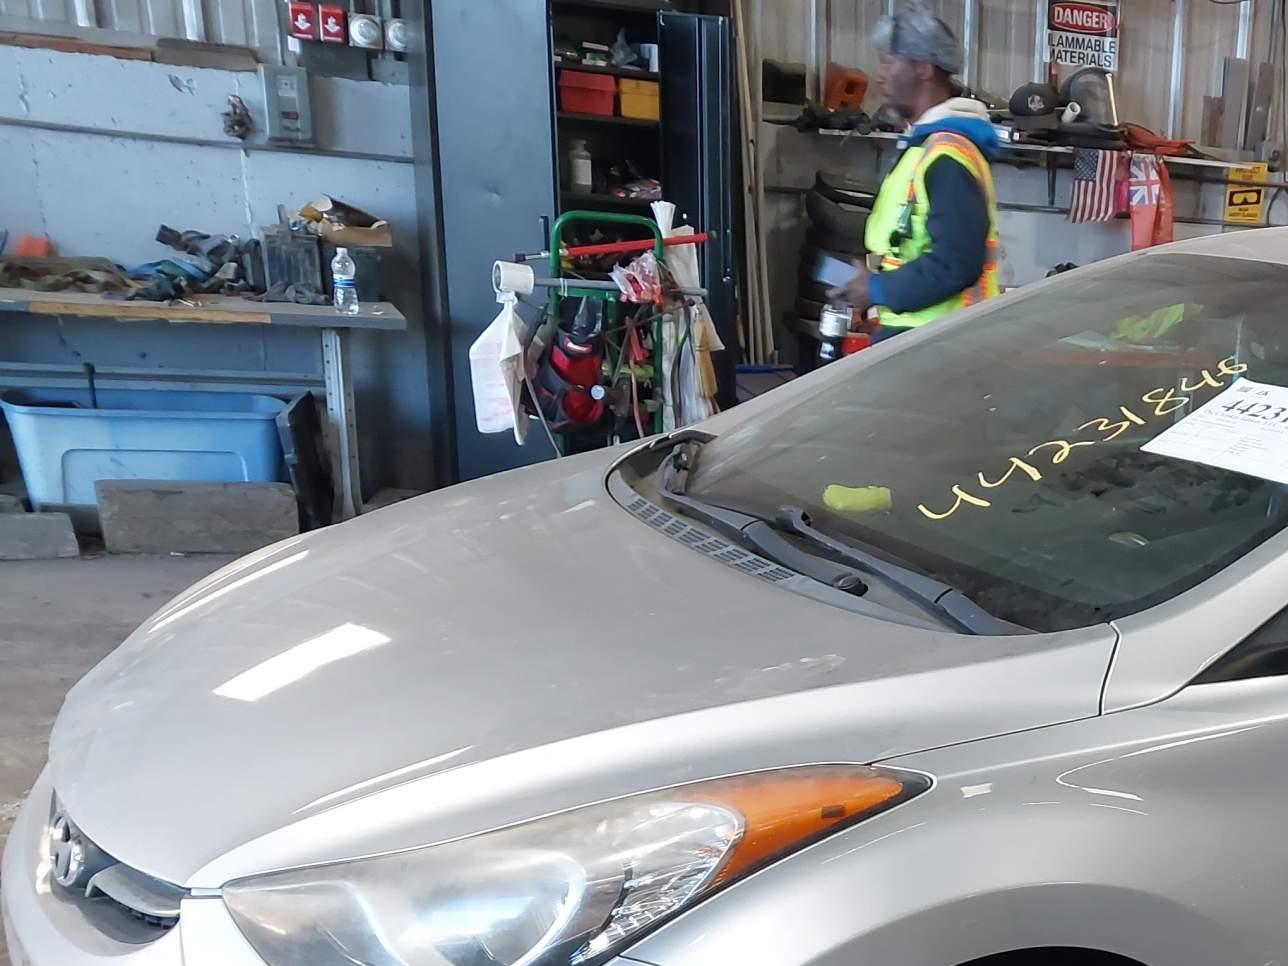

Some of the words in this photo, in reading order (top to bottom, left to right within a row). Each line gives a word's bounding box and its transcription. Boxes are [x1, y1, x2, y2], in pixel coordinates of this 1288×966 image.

[1054, 7, 1108, 30] DANGER
[1048, 33, 1116, 54] LAMMABLE
[917, 356, 1248, 520] 44231846
